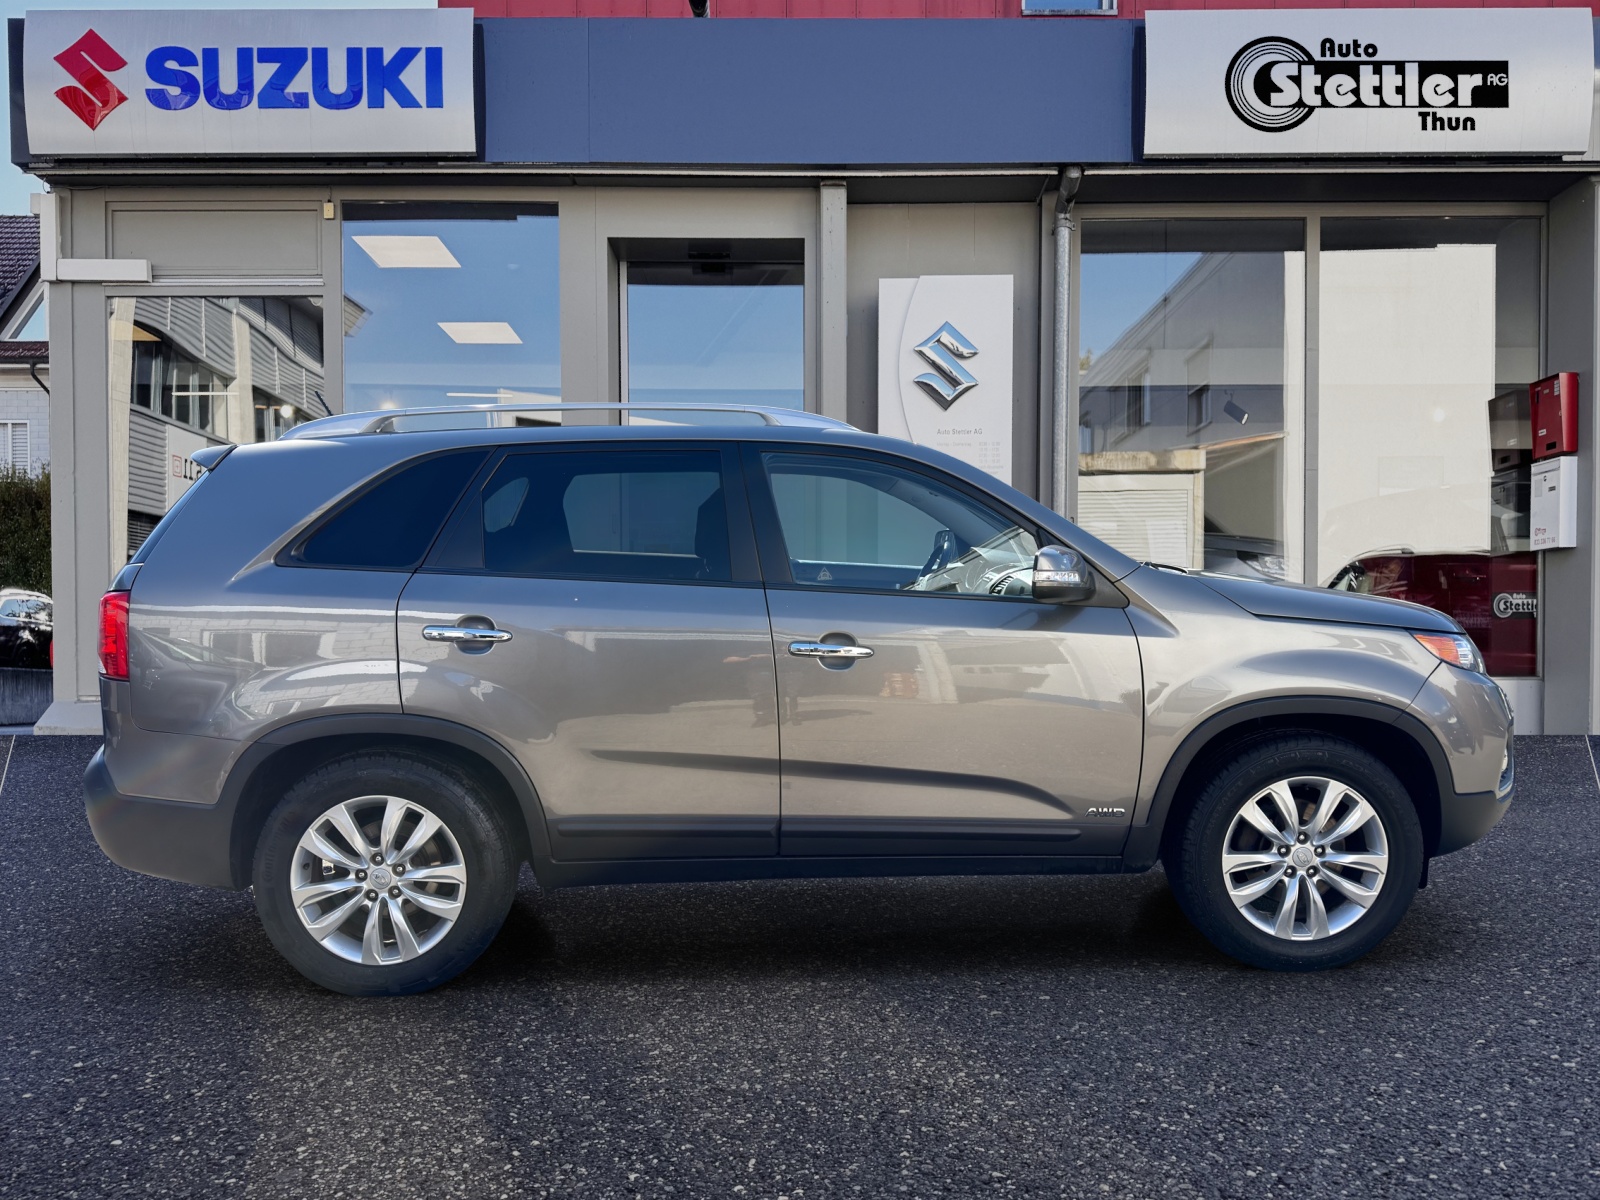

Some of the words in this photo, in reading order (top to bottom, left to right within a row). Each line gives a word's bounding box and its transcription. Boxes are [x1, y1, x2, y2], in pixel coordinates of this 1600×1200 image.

[1320, 38, 1378, 58] Auto
[145, 46, 443, 110] SUZUKI
[1270, 62, 1483, 107] Stettler
[1487, 73, 1508, 86] AG
[1418, 111, 1475, 131] Thun
[1084, 807, 1126, 817] AWD
